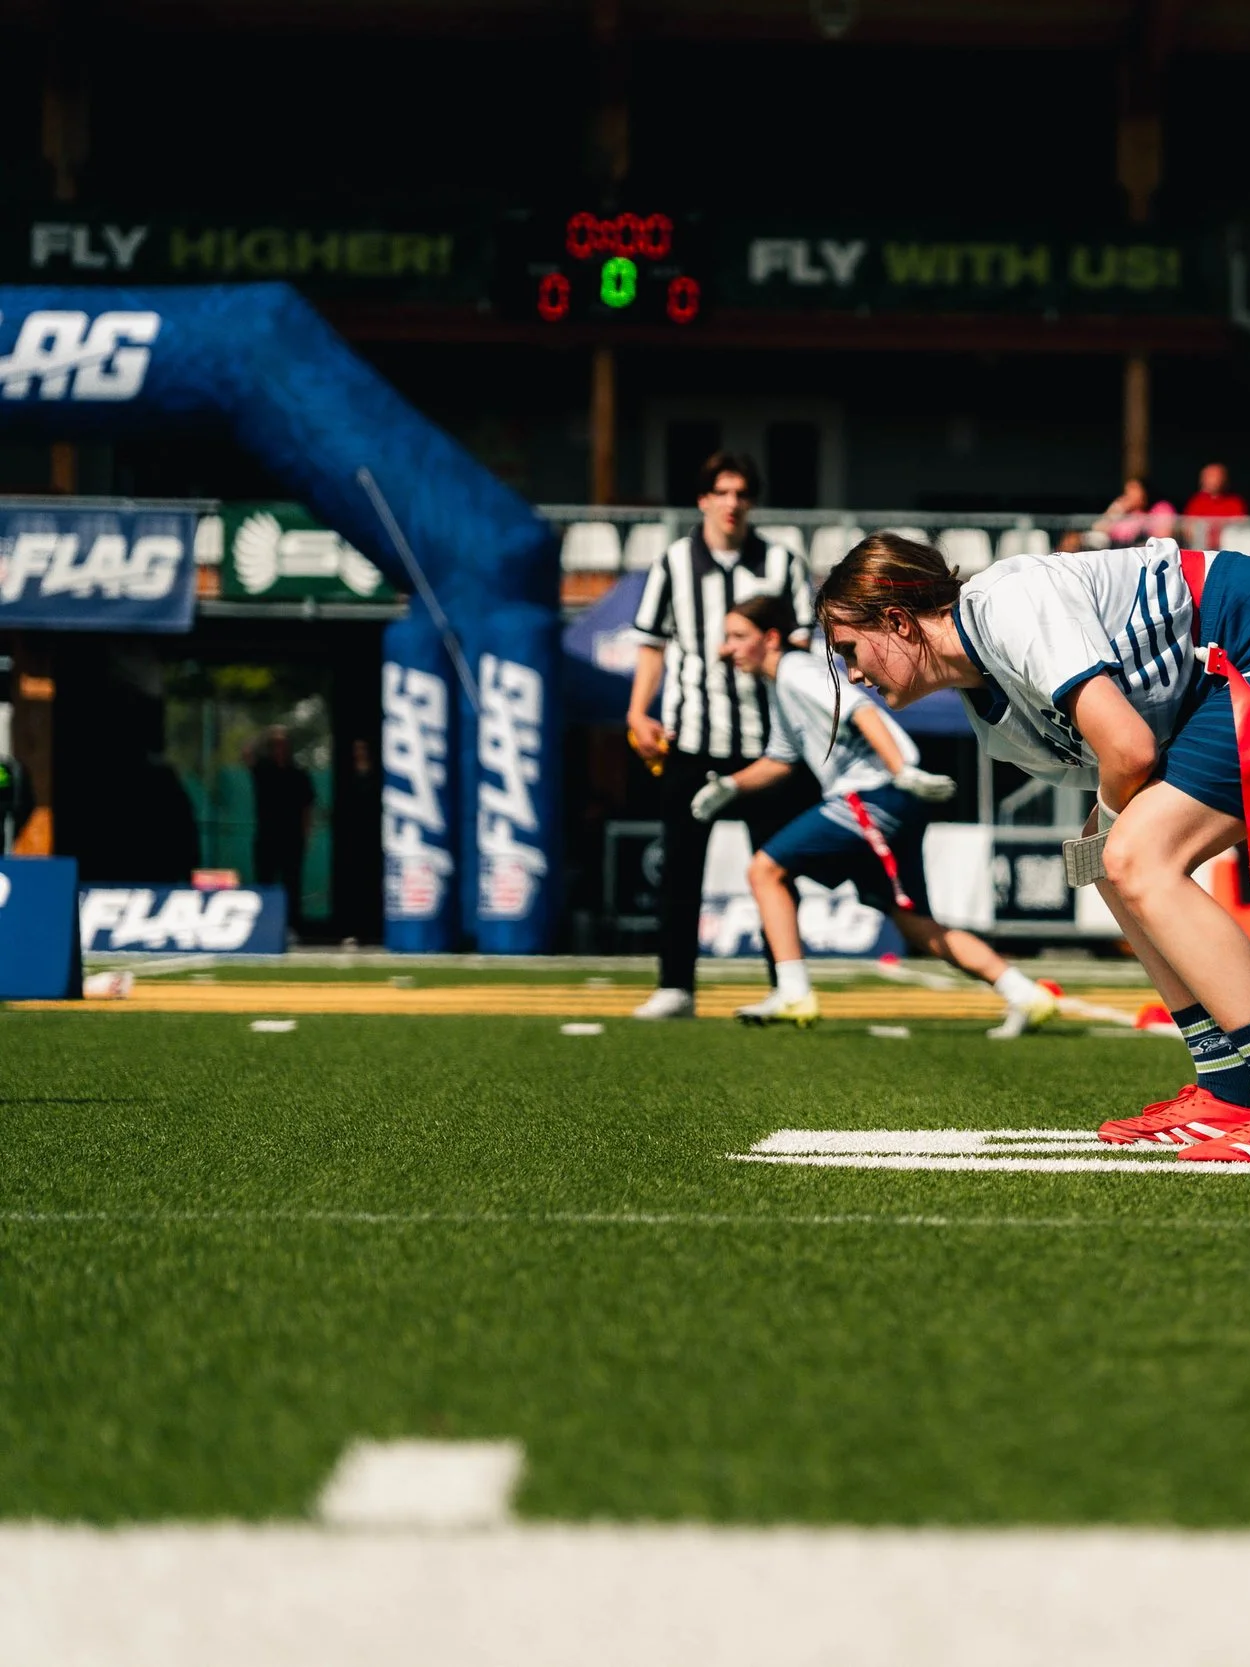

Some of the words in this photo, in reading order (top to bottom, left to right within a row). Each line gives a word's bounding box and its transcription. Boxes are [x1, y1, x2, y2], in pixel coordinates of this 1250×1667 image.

[29, 221, 149, 270] FLY
[168, 226, 455, 275] HIGHER!
[564, 210, 675, 261] 0:00
[599, 256, 639, 309] 0
[747, 237, 869, 287] FLY
[881, 240, 1051, 289] WITH
[1068, 244, 1181, 292] US!
[537, 272, 572, 323] 0
[666, 275, 702, 325] 0
[0, 310, 161, 400] AG
[0, 532, 184, 604] FLAG
[381, 660, 454, 876] FLAG
[477, 652, 547, 876] FLAG
[79, 887, 262, 952] FLAG
